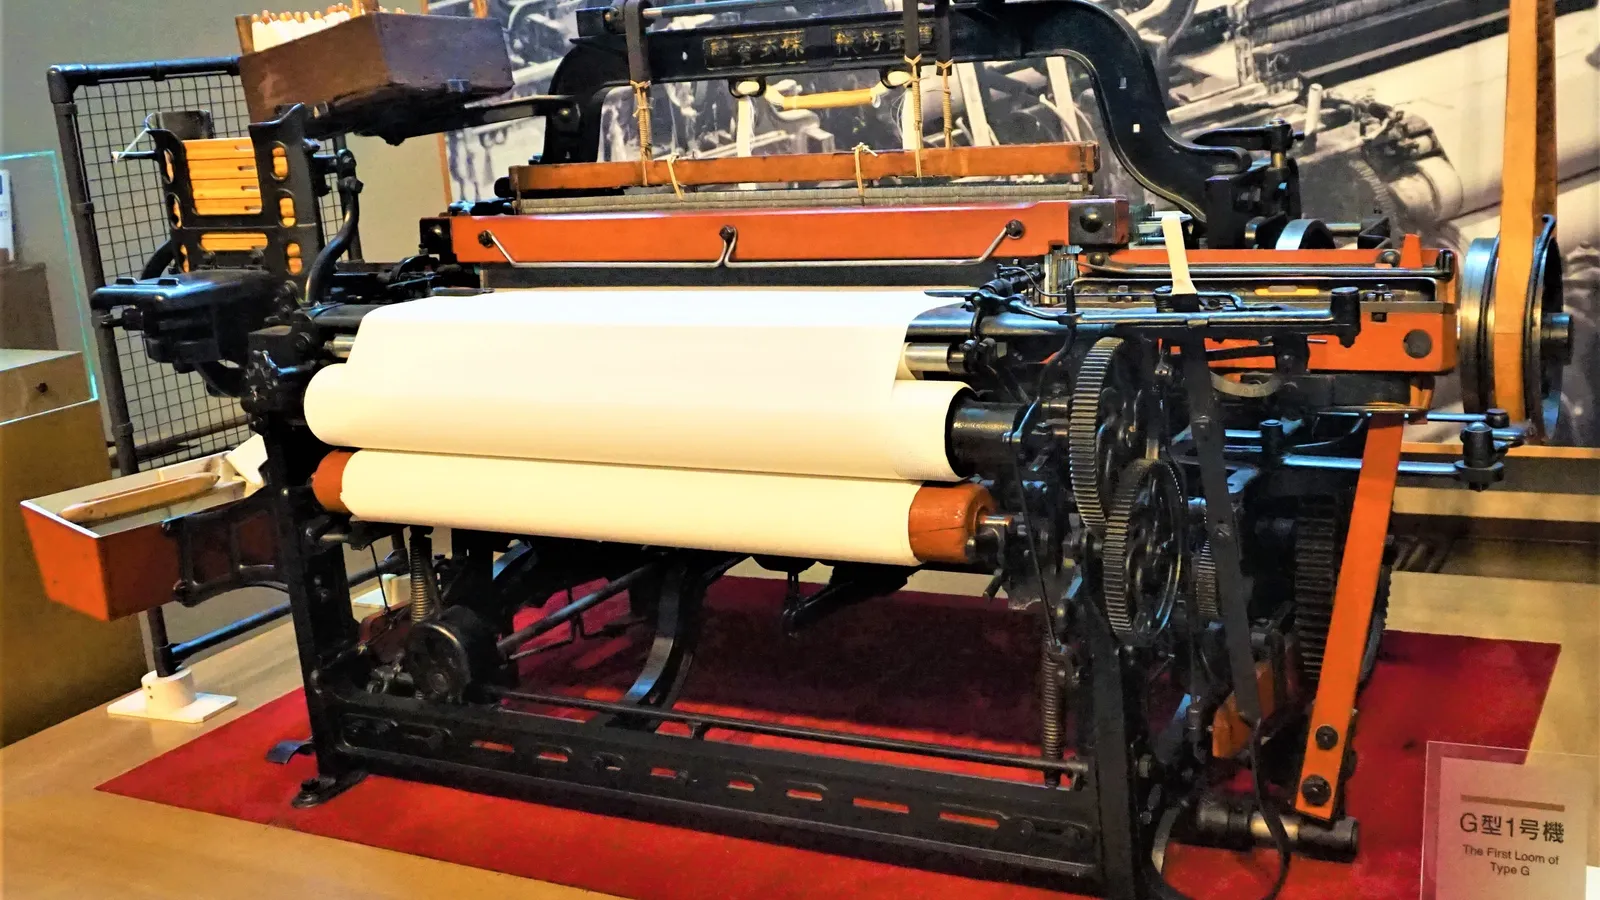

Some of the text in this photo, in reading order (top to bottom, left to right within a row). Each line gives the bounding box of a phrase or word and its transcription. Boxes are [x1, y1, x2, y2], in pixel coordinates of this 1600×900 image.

[1460, 812, 1565, 843] G型1号機
[1463, 844, 1559, 865] The First Loom of
[1490, 862, 1530, 876] Type G
